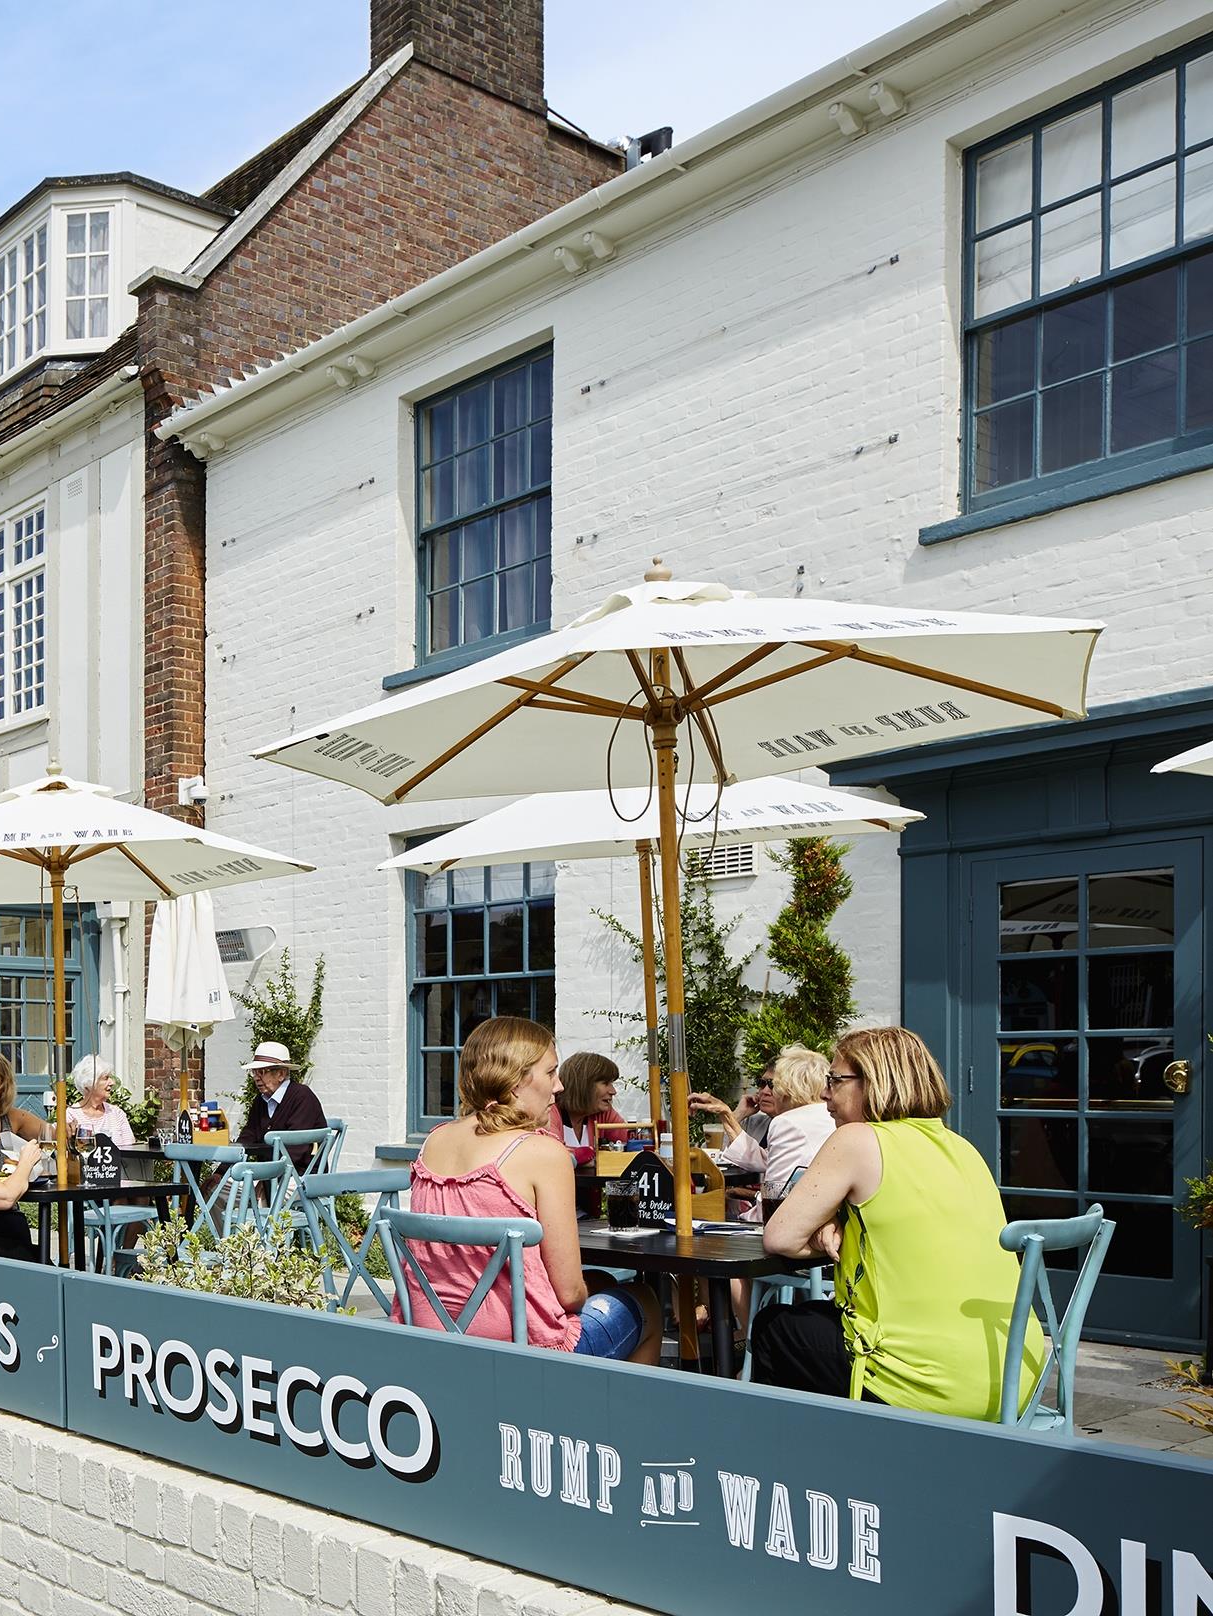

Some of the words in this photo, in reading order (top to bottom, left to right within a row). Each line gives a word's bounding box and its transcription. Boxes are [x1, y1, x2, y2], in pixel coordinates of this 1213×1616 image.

[768, 801, 844, 816] WADE
[93, 1146, 113, 1164] 43
[94, 1171, 105, 1179] The
[105, 1169, 117, 1179] Bar
[101, 1163, 119, 1172] Order
[639, 1172, 659, 1198] 41
[649, 1200, 672, 1210] Order
[638, 1209, 652, 1219] The
[91, 1322, 438, 1478] PROSECCO
[499, 1422, 622, 1515] RUMP
[641, 1470, 694, 1517] AND
[717, 1470, 882, 1584] WADE
